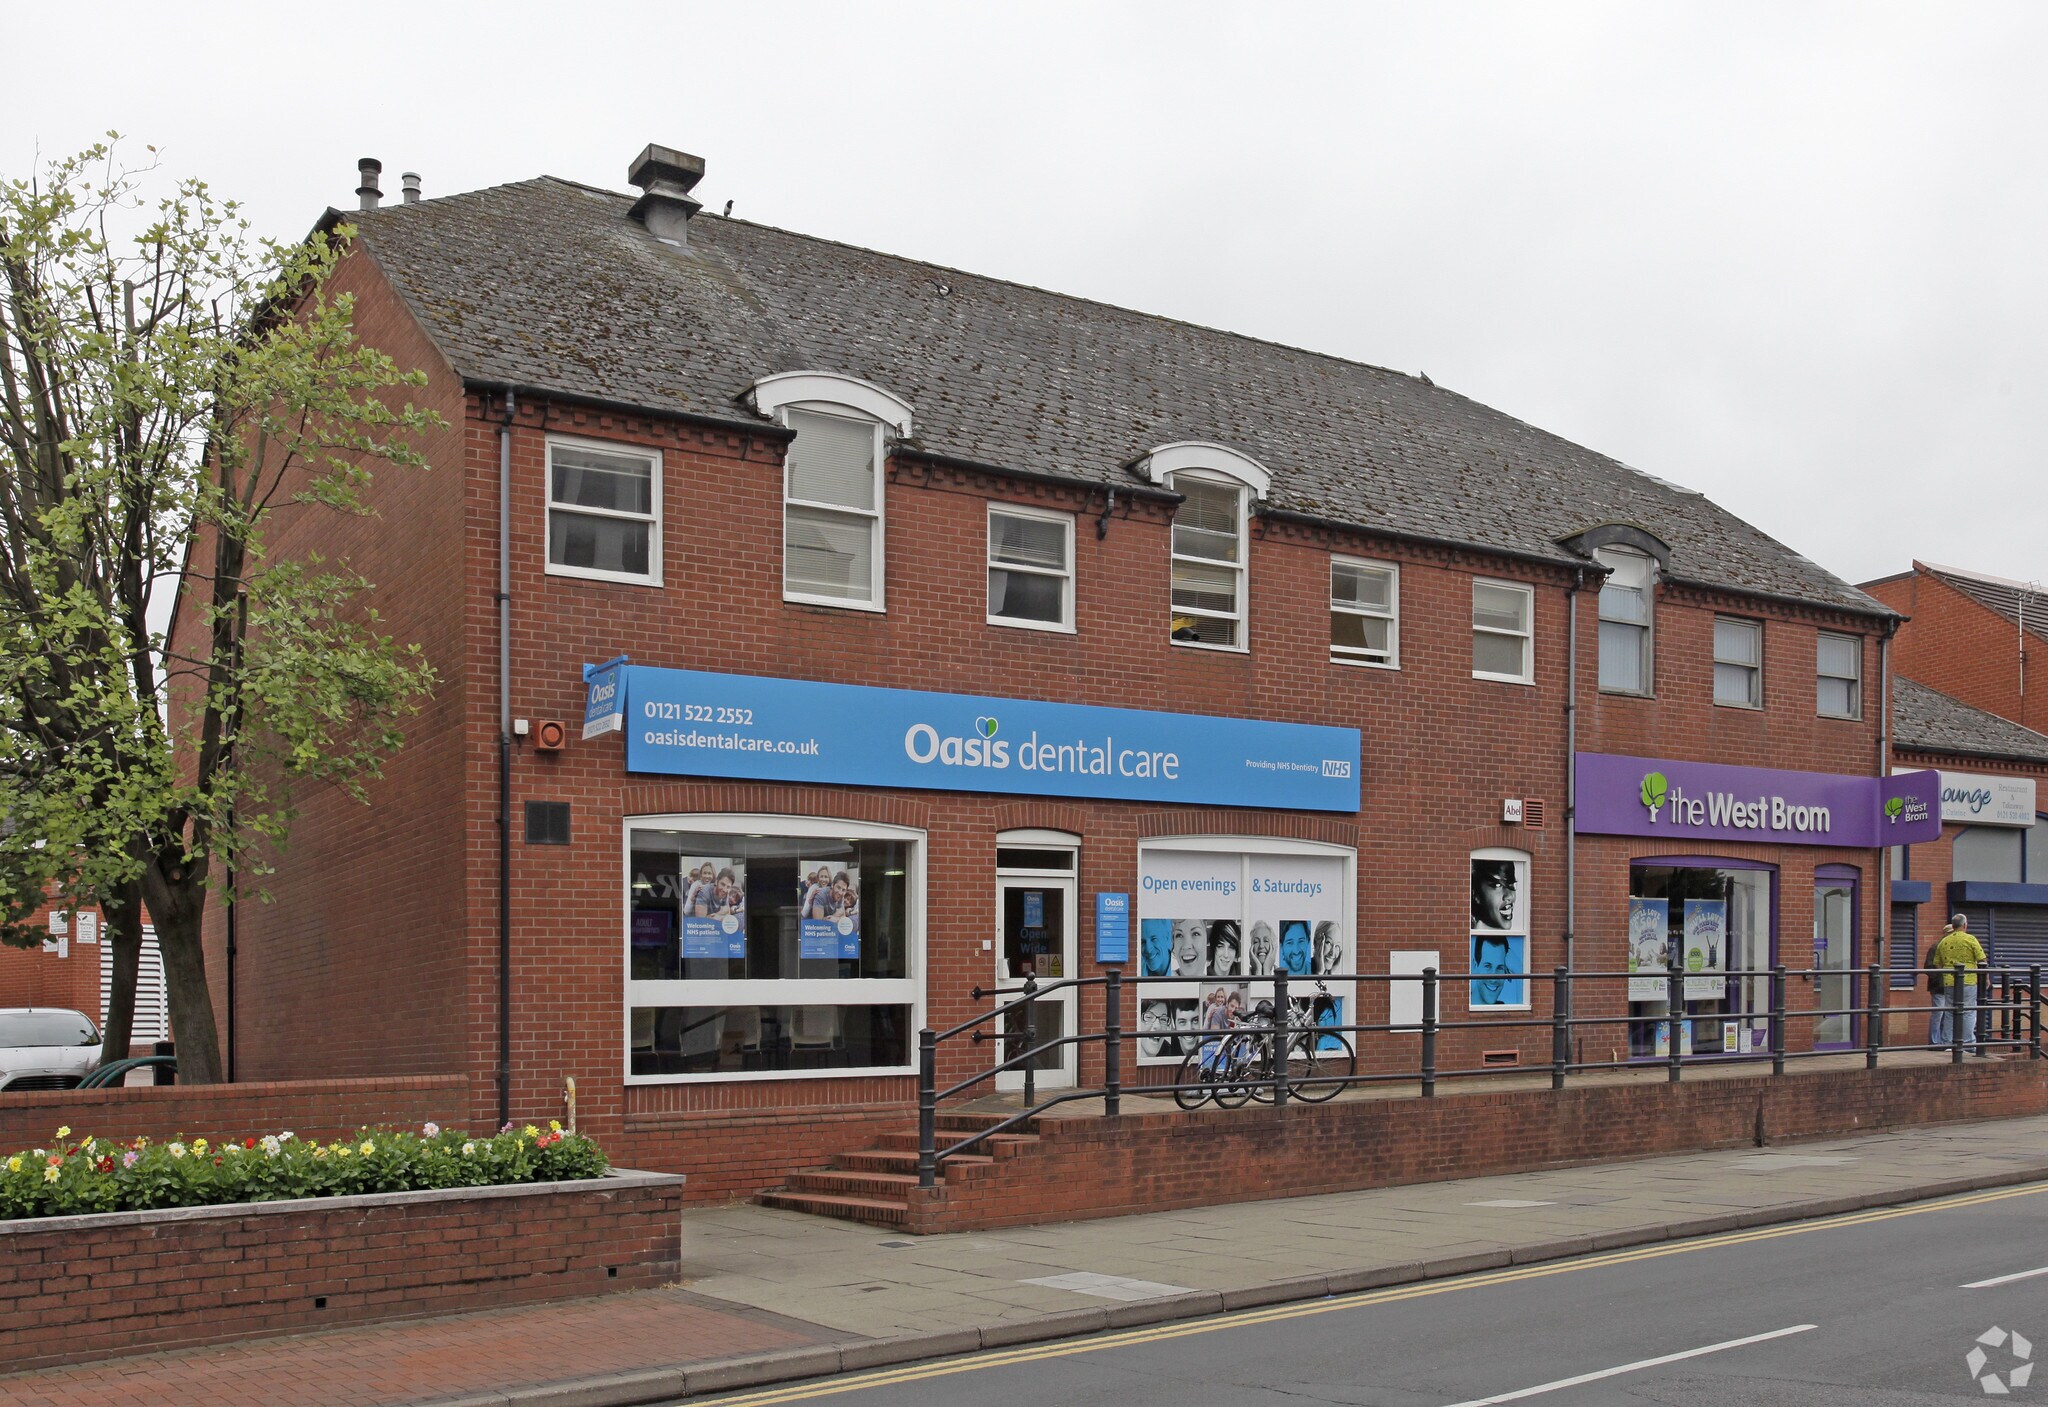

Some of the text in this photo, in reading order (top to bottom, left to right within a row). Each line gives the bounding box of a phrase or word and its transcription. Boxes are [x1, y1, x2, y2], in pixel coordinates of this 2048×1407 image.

[592, 683, 616, 705] Oasis
[588, 701, 614, 718] dental care
[645, 701, 753, 725] 0121 522 2552
[644, 729, 820, 756] oasisdentalcare.co.uk
[904, 723, 1179, 780] Oasis dental care
[1245, 759, 1319, 774] Providing NHS Dentistry
[1323, 761, 1349, 776] NHS
[1998, 783, 2028, 793] Restaurant
[1904, 795, 1917, 804] the
[1941, 786, 1992, 814] ounge
[1506, 805, 1521, 816] Abel
[1670, 786, 1830, 833] the West Brom
[1905, 803, 1928, 813] West
[1905, 811, 1928, 822] Brom
[1142, 875, 1322, 898] Open evenings & Saturdays
[1104, 897, 1124, 907] Oasis
[1020, 928, 1047, 942] Open
[1020, 942, 1047, 954] Wide
